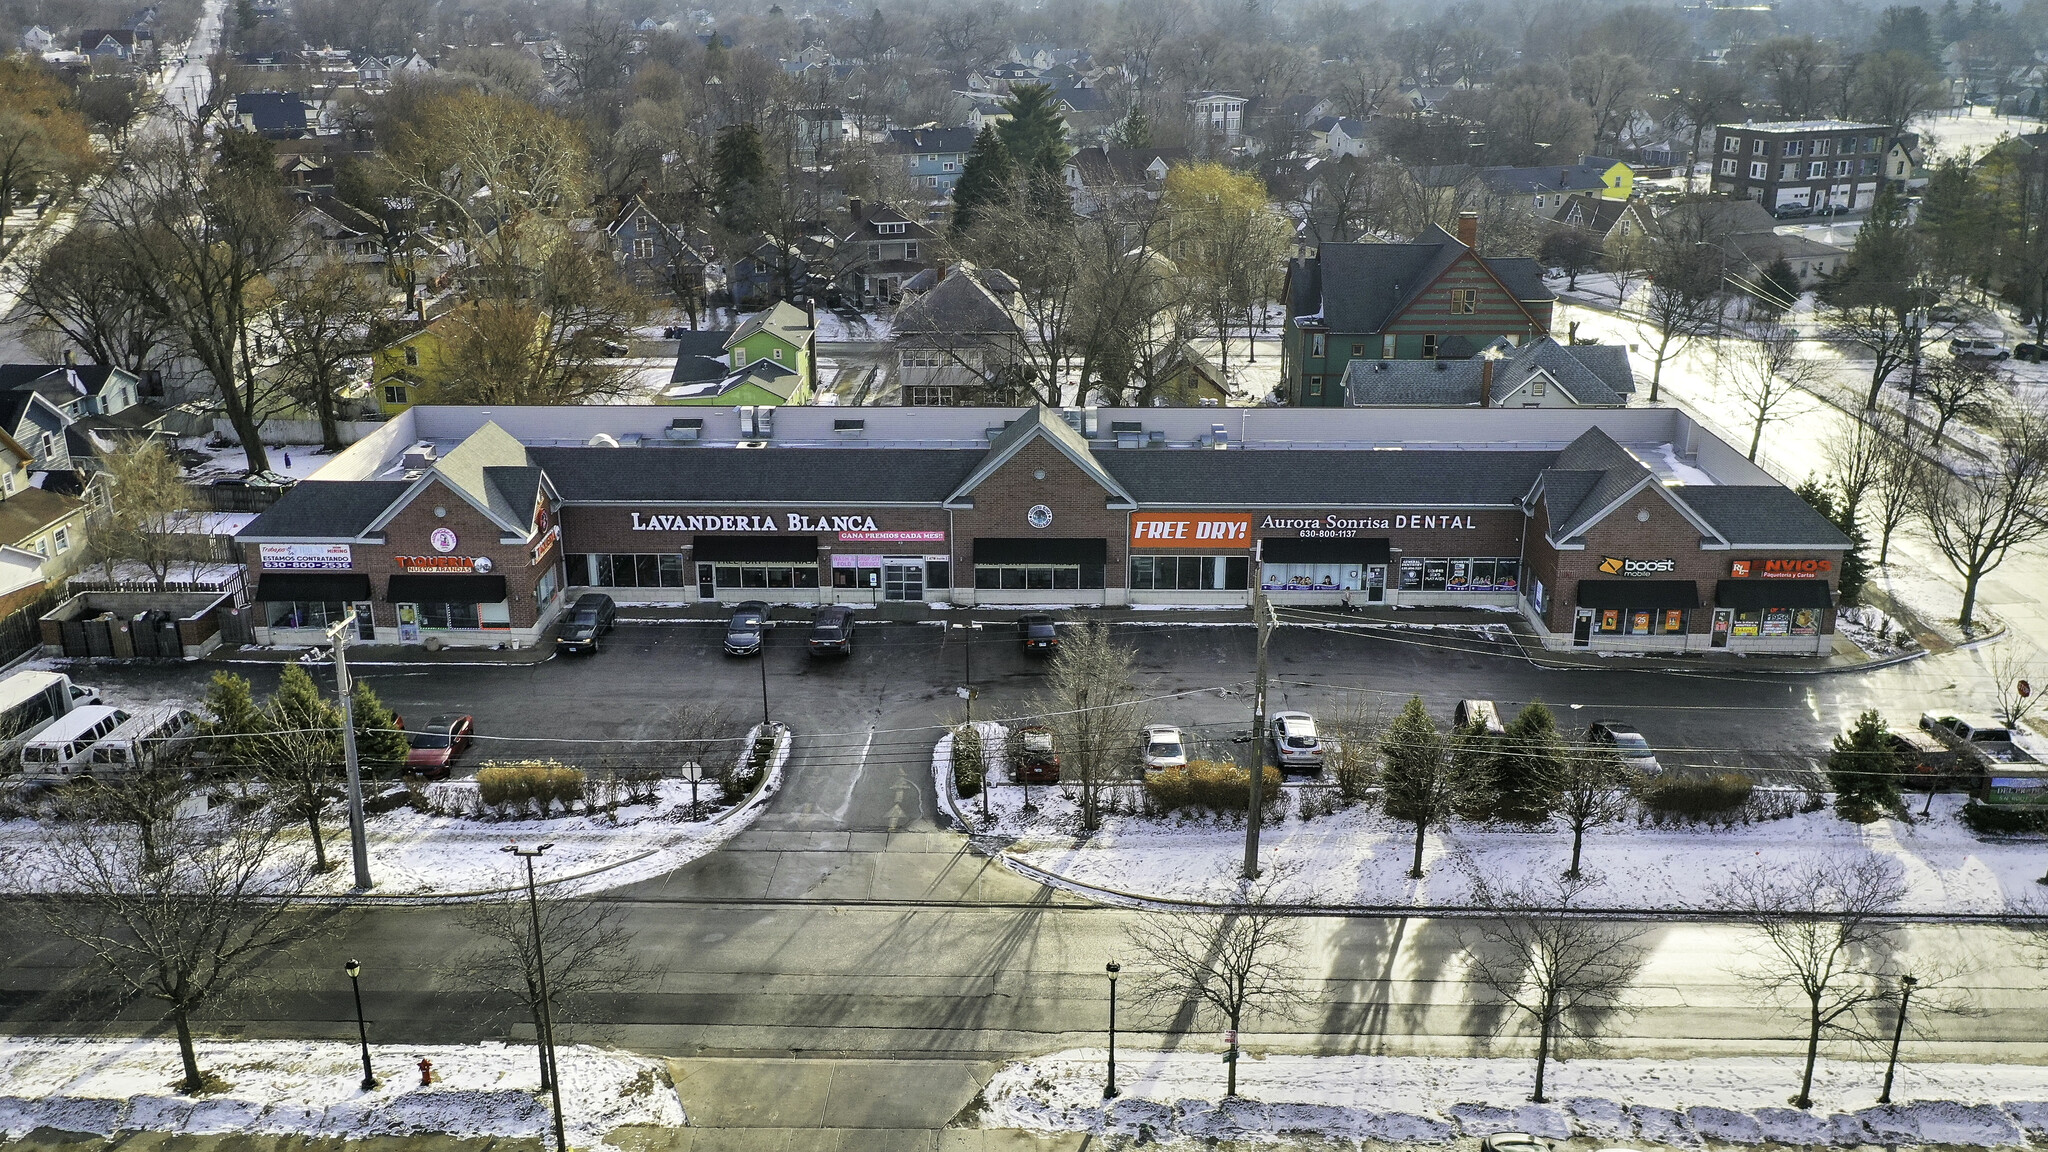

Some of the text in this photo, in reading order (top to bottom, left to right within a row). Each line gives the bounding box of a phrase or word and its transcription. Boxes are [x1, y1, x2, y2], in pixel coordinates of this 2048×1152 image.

[631, 512, 878, 531] LAVANDERIA BLANCA
[1260, 514, 1476, 529] Aurora Sonrisa DENTAL
[1134, 521, 1247, 539] FREE DRY!
[1299, 530, 1356, 538] 630-800-1137
[395, 556, 474, 569] TAQUERIA
[1625, 559, 1675, 571] boost
